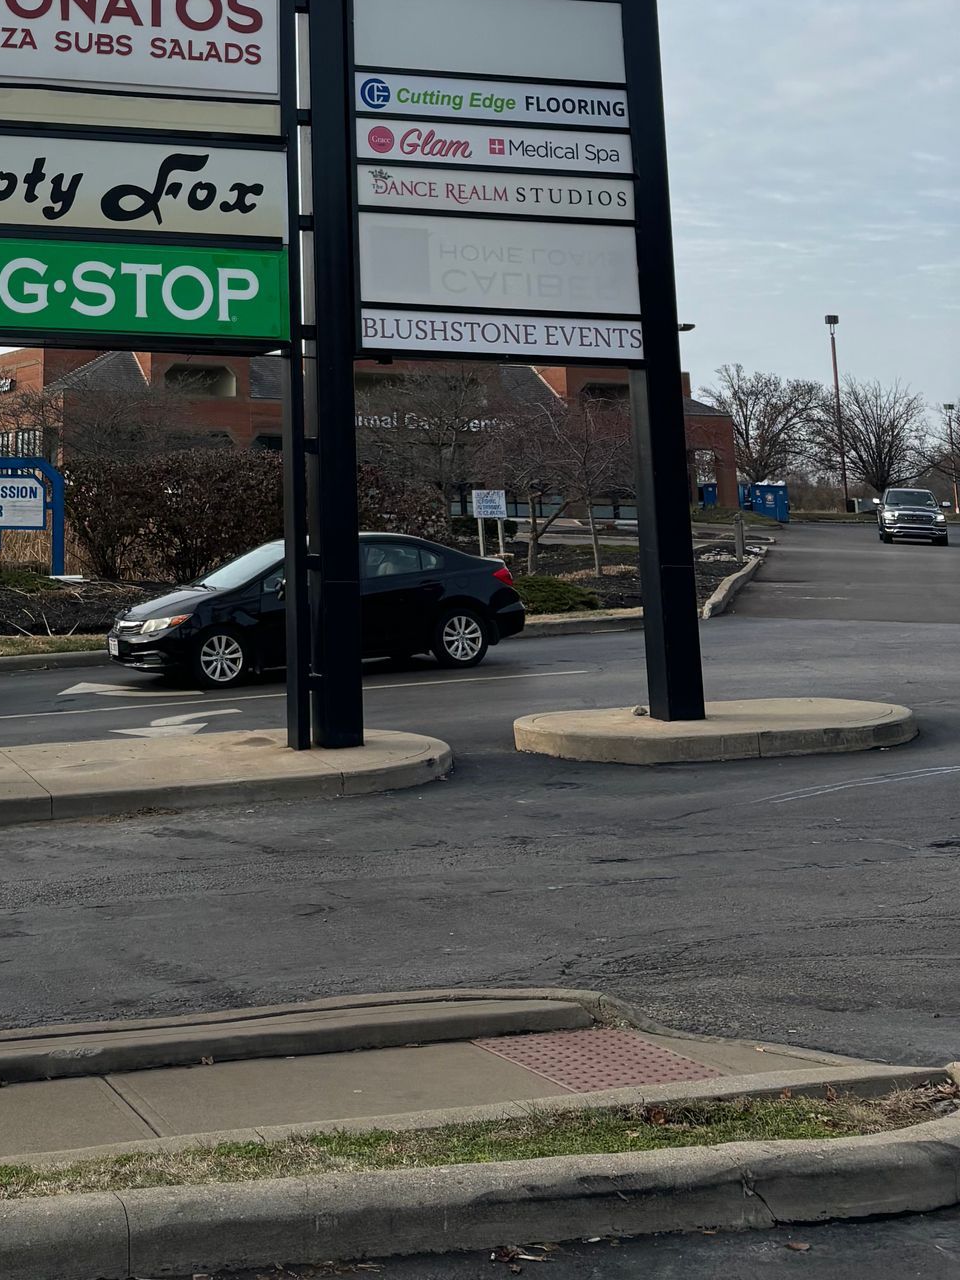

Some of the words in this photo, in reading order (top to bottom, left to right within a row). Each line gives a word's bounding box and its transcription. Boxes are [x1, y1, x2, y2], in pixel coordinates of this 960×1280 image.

[54, 30, 133, 56] SUBS
[149, 38, 262, 65] SALADS
[396, 87, 464, 111] Cutting
[469, 92, 516, 113] Edge
[525, 95, 625, 117] FLOORING
[400, 128, 472, 158] Glam
[509, 139, 579, 160] Medical
[585, 143, 620, 164] Spa
[100, 153, 264, 226] Fox
[374, 178, 439, 198] DANCE
[445, 183, 509, 205] REALM
[516, 187, 627, 207] STUDIOS
[362, 317, 537, 345] BLUSHSTONE
[544, 325, 642, 349] EVENTS
